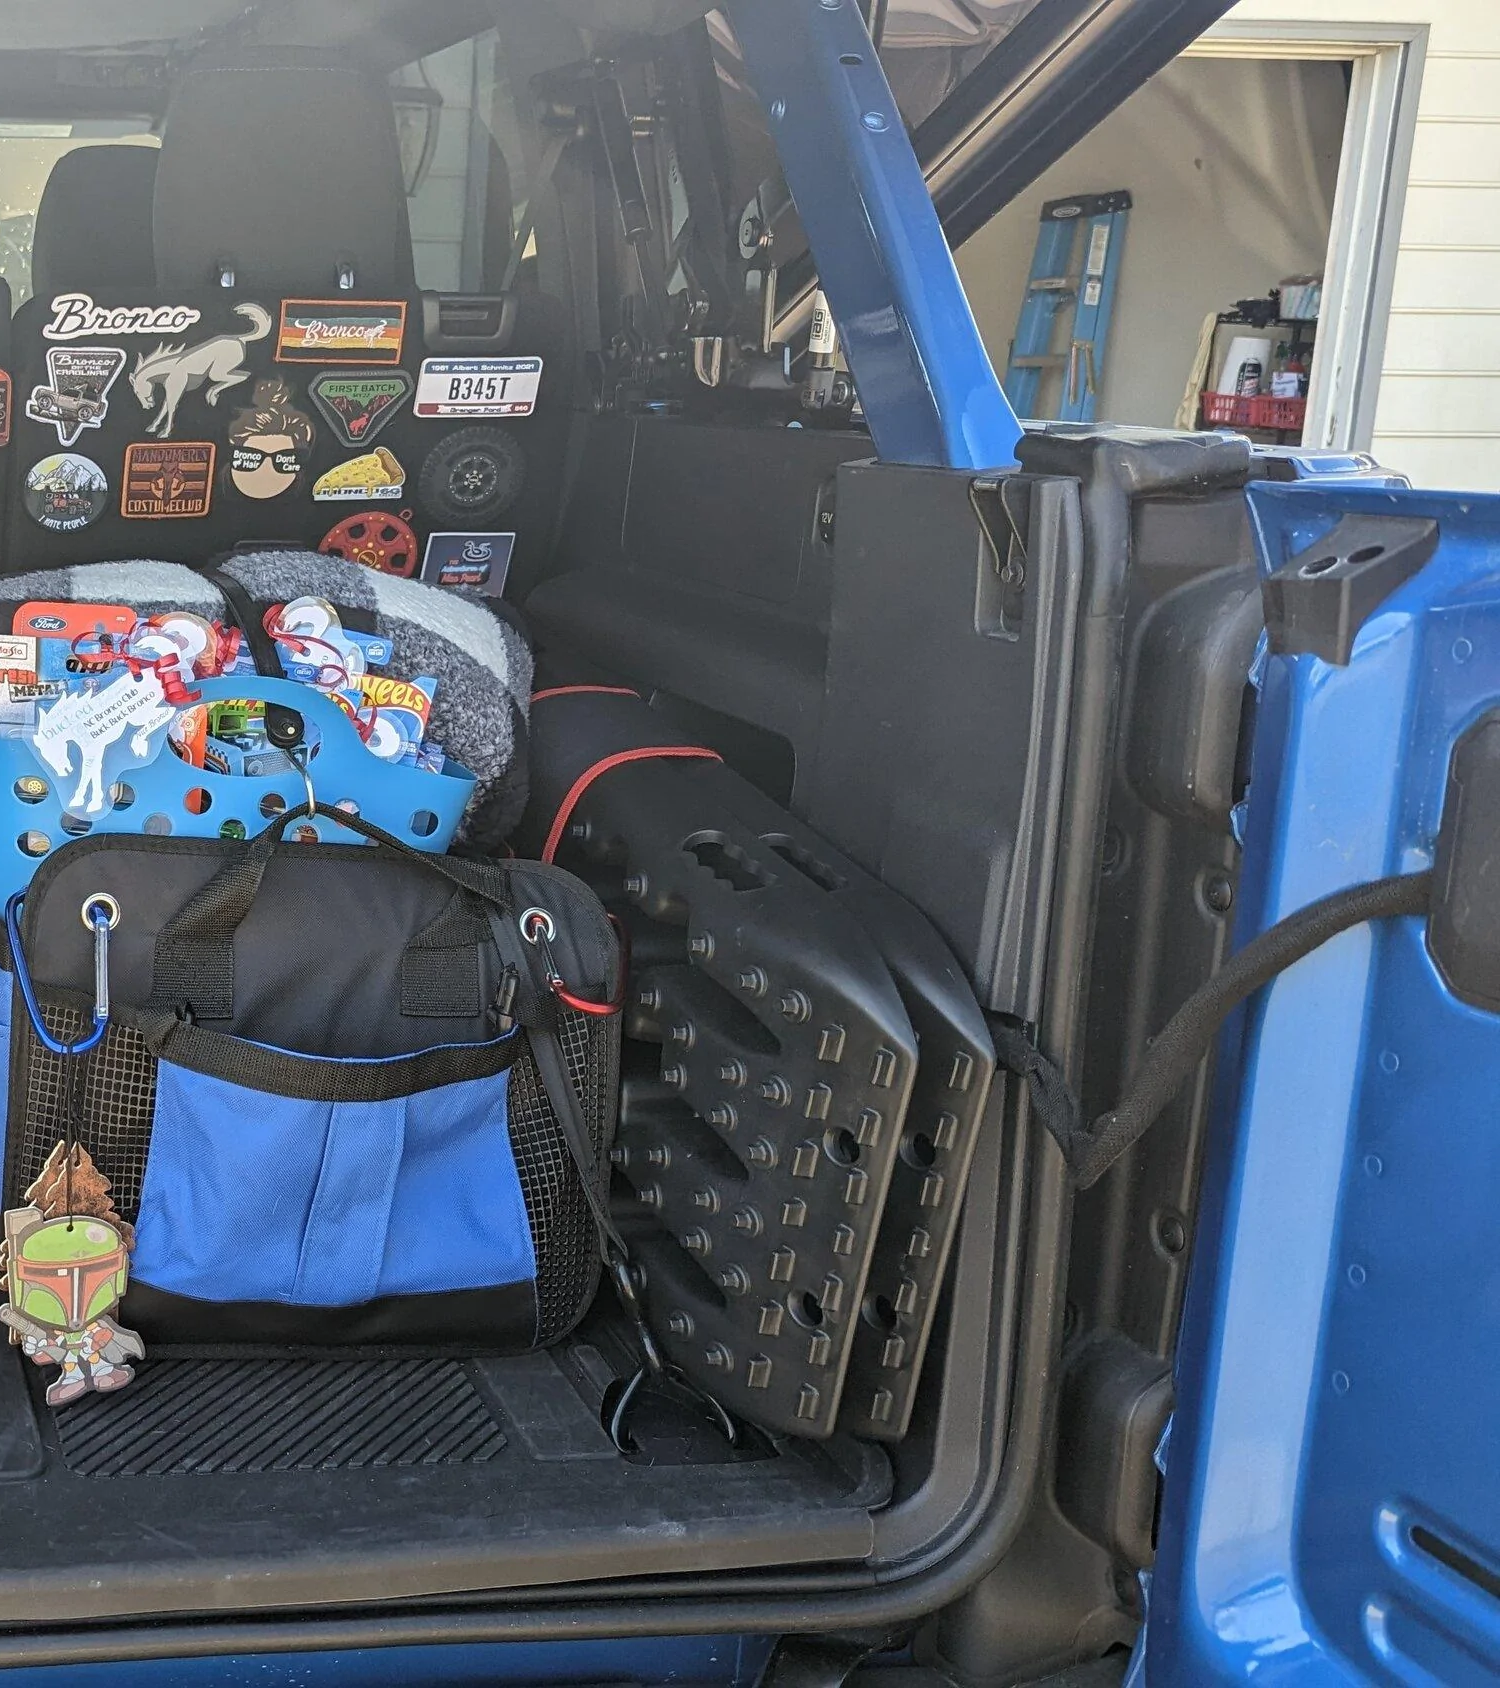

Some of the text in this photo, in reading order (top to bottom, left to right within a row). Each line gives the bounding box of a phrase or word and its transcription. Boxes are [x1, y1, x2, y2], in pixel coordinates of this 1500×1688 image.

[47, 298, 196, 336] Bronco
[294, 319, 364, 347] Bronco
[55, 354, 117, 366] Broncos
[329, 383, 396, 393] FIRST BATCH
[448, 377, 511, 400] B345T
[233, 450, 262, 461] Bronco
[275, 454, 296, 464] Dont
[242, 460, 261, 469] Hair
[282, 463, 301, 471] Care
[62, 516, 89, 531] PEOPLE
[821, 512, 834, 524] 12V
[34, 617, 61, 630] Ford
[13, 684, 61, 698] METAL
[82, 688, 140, 729] NC Bronco Club
[89, 690, 156, 740] Buck Buck Bronco
